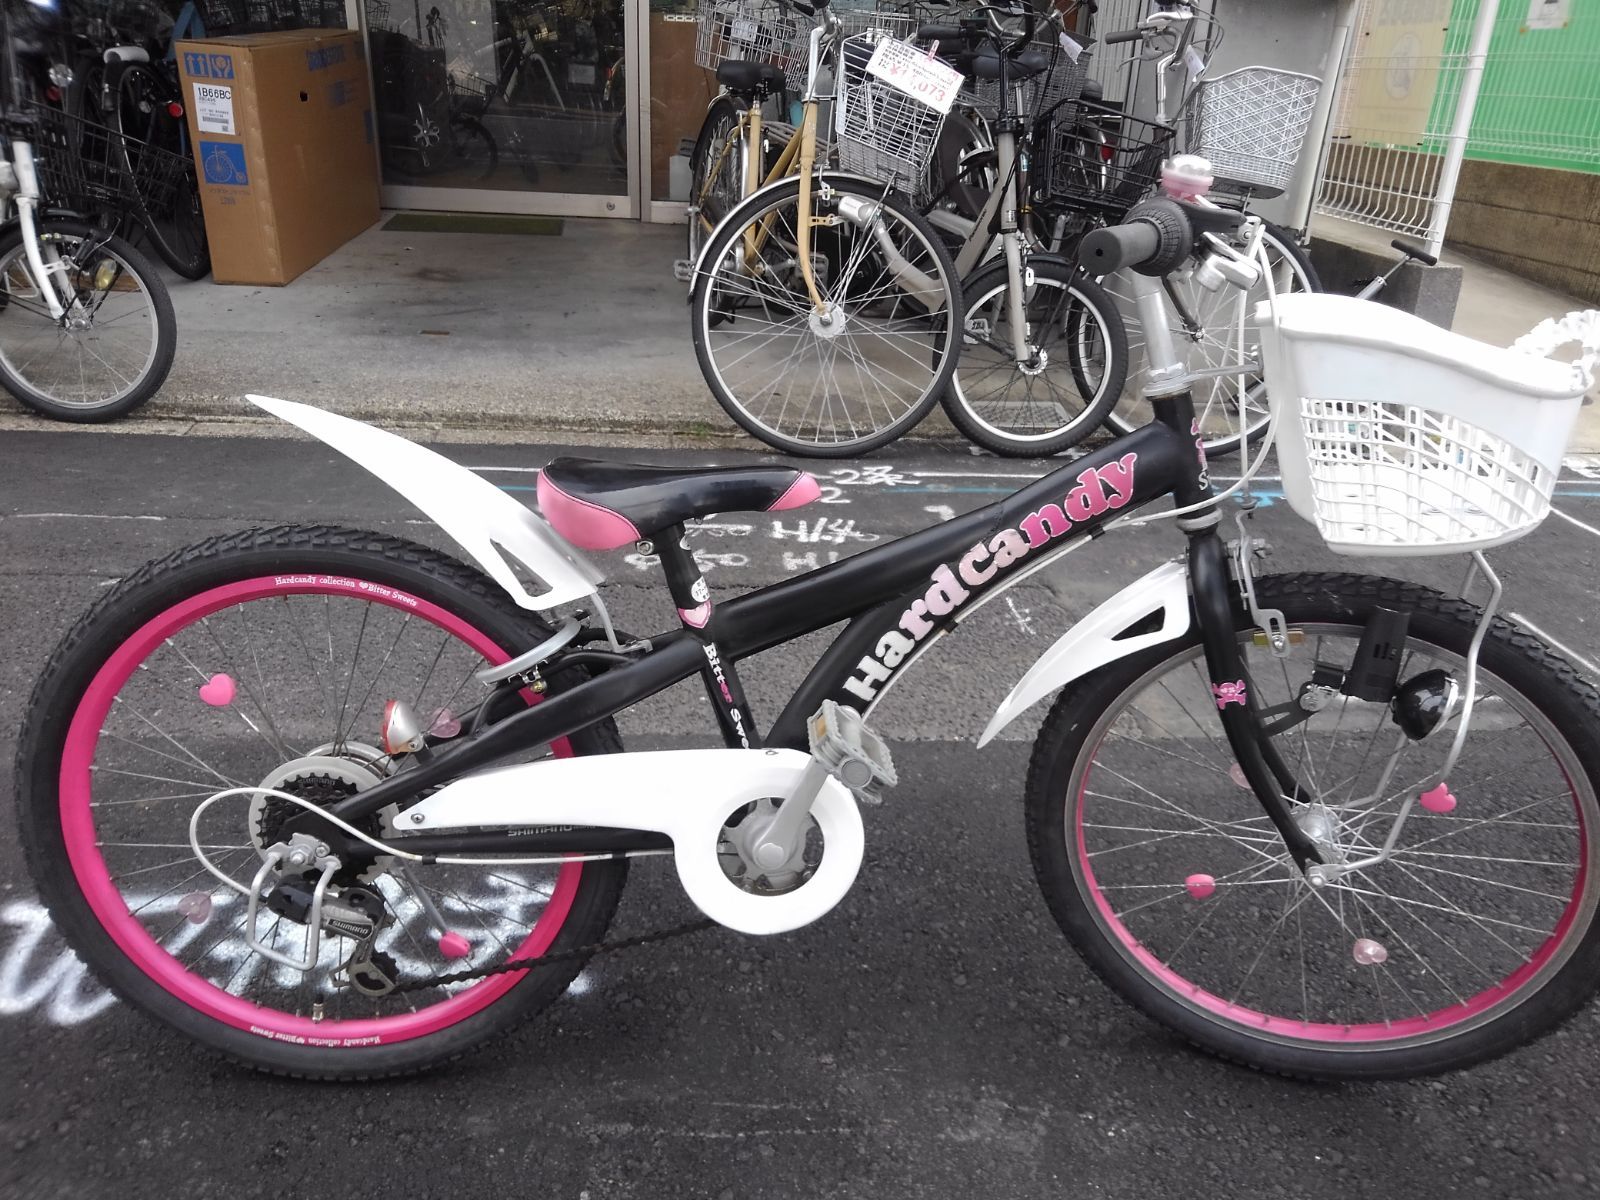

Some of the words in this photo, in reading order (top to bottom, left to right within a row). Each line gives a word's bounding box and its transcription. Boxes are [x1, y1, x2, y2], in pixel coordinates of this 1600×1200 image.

[198, 87, 232, 100] 1B66BC
[889, 62, 947, 102] ¥1,073
[274, 575, 317, 586] Hardcandy
[319, 576, 356, 588] collection
[367, 583, 391, 596] Bitter
[392, 591, 417, 606] Sweets
[842, 452, 1138, 701] Hardcandy
[702, 642, 733, 703] Bitter
